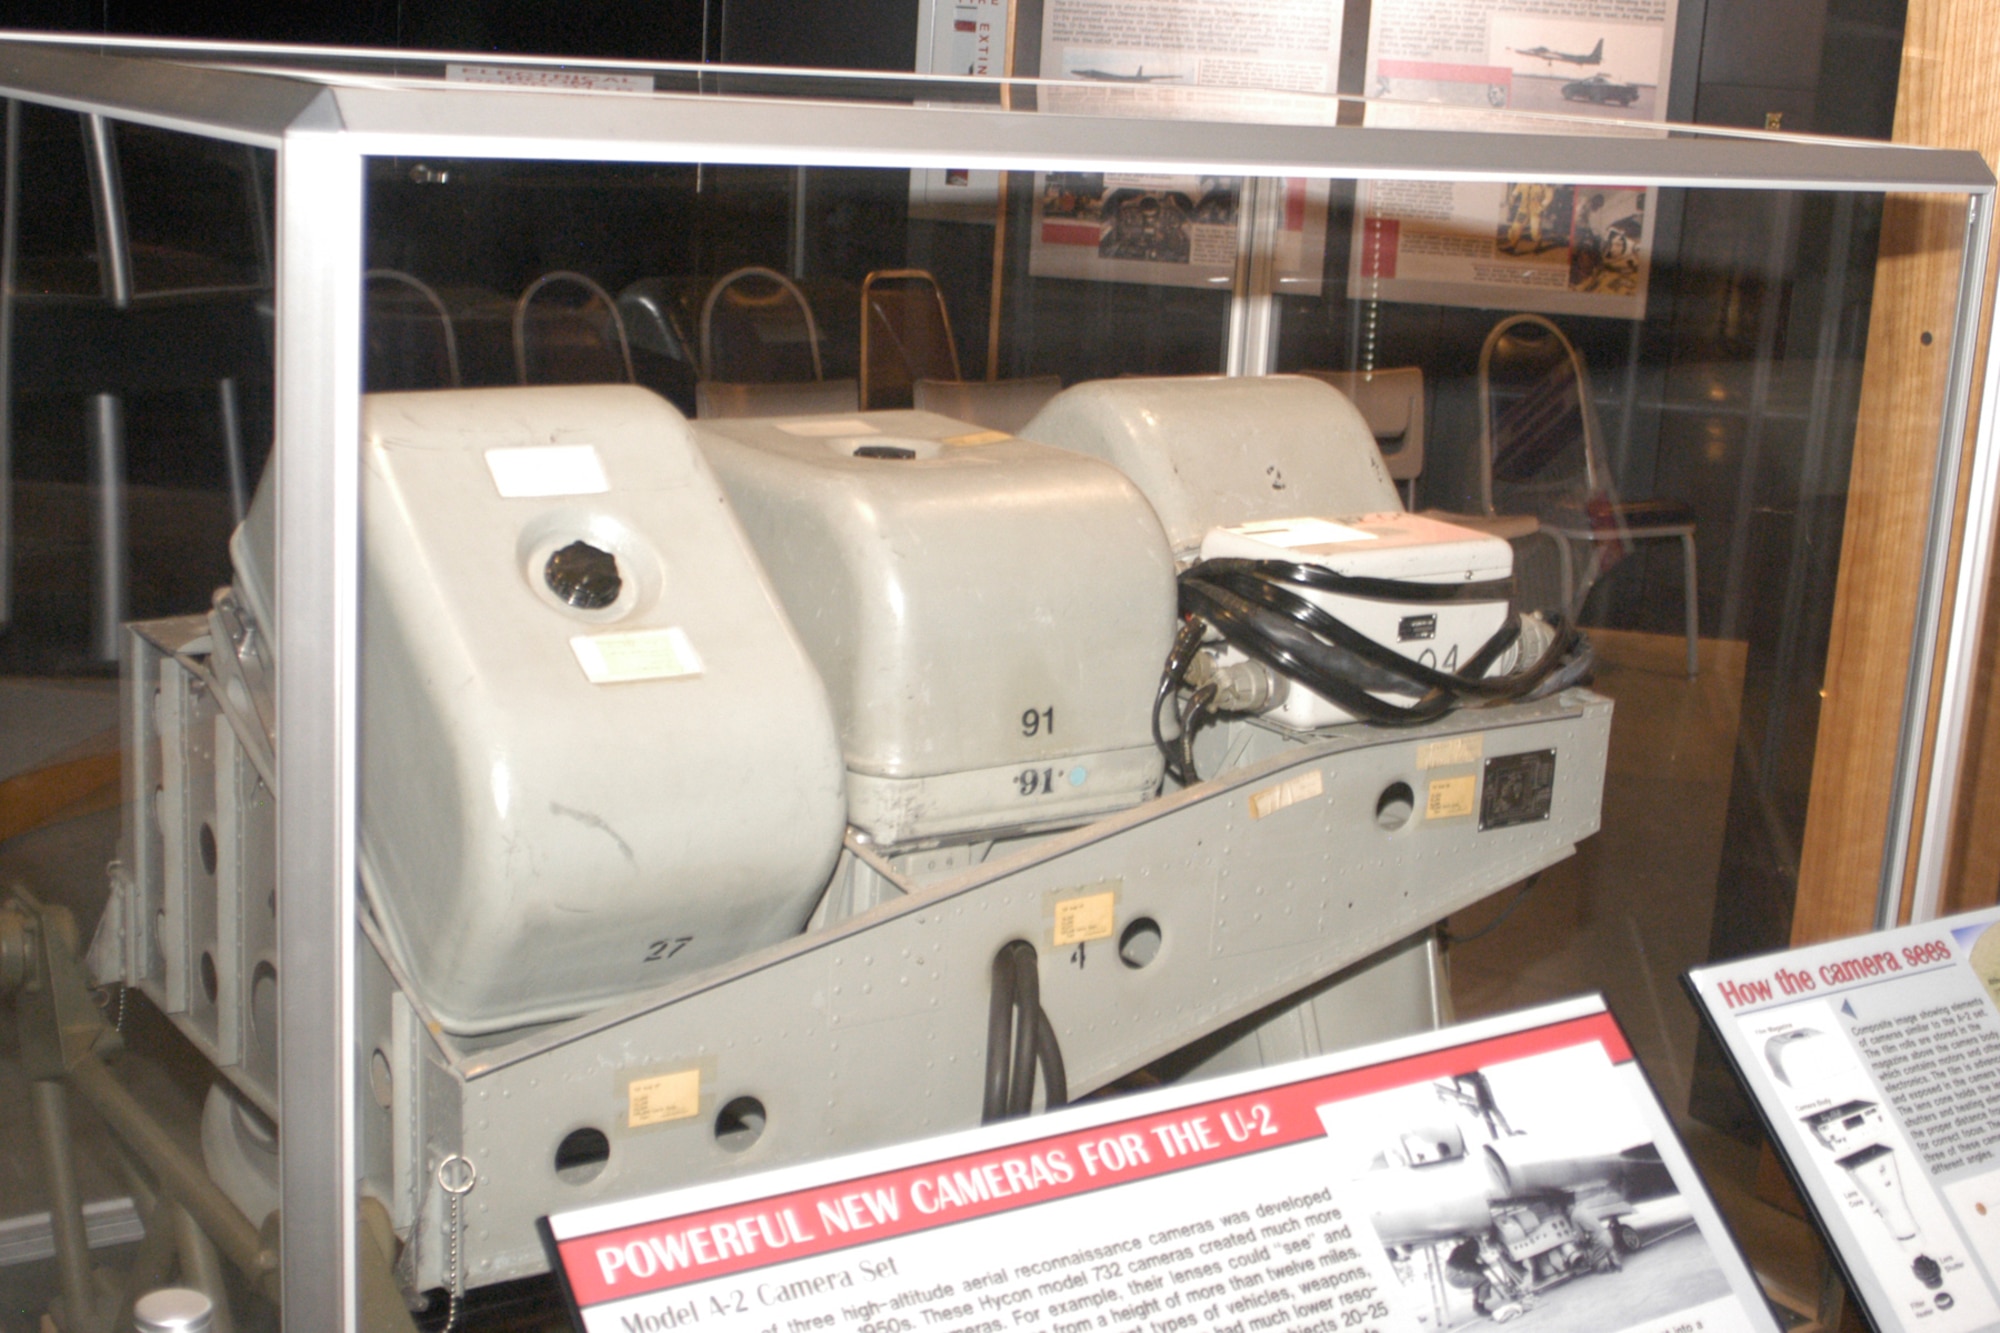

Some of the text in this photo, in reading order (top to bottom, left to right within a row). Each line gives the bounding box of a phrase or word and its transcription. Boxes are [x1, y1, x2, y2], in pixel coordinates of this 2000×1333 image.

[1021, 705, 1053, 737] 91
[1019, 767, 1053, 796] 91
[643, 936, 694, 963] 27
[1717, 940, 1952, 1008] How the camera sees
[1851, 1020, 1893, 1037] Composite
[1919, 1006, 1950, 1020] showing
[1859, 1038, 1868, 1048] of
[1869, 1031, 1903, 1045] cameras
[1904, 1023, 1930, 1036] similar
[1931, 1020, 1941, 1030] to
[1942, 1016, 1955, 1027] the
[1864, 1023, 1981, 1059] The film rolls are stored in the
[1871, 1054, 1910, 1070] magazine
[1910, 1048, 1934, 1060] above
[1935, 1043, 1949, 1053] the
[1950, 1036, 1980, 1050] camera
[1879, 1069, 1902, 1081] which
[1903, 1060, 1937, 1075] contains
[1938, 1053, 1965, 1065] motors
[1967, 1047, 1982, 1058] and
[1930, 1070, 1947, 1080] The
[1948, 1065, 1964, 1076] film
[1896, 1084, 1991, 1117] The lens cone holds the
[1908, 1083, 1943, 1100] exposed
[1943, 1081, 1952, 1091] in
[1952, 1078, 1966, 1088] the
[1968, 1070, 1997, 1084] camera
[1904, 1099, 1986, 1128] shutters and heating
[1910, 1112, 1988, 1140] the proper distance
[1923, 1151, 1946, 1163] three
[1947, 1145, 1956, 1157] of
[1957, 1140, 1980, 1153] these
[1931, 1132, 1960, 1147] correct
[1931, 1157, 1965, 1175] different
[595, 1103, 1278, 1285] POWERFUL NEW CAMERAS FOR THE U-2
[786, 1313, 836, 1333] three
[841, 1283, 954, 1322] high-altitude
[962, 1268, 1009, 1292] aerial
[1014, 1238, 1142, 1279] reconnaissance
[1148, 1219, 1215, 1246] cameras
[1219, 1210, 1251, 1227] was
[1255, 1187, 1333, 1219] developed
[919, 1302, 974, 1325] These
[978, 1286, 1034, 1312] Hycon
[1038, 1270, 1088, 1297] model
[1091, 1261, 1123, 1282] 732
[1128, 1246, 1195, 1273] cameras
[1198, 1227, 1257, 1256] created
[1260, 1217, 1302, 1239] much
[1304, 1207, 1343, 1228] more
[1012, 1308, 1041, 1327] For
[1048, 1287, 1124, 1318] example,
[1128, 1275, 1164, 1296] their
[1168, 1260, 1223, 1285] lenses
[1228, 1246, 1271, 1271] could
[1324, 1223, 1352, 1245] and
[621, 1256, 899, 1333] Model A-2 Camera Set
[1052, 1247, 1362, 1333] from a height of more than twelve miles.
[1150, 1266, 1372, 1333] types of vehicles, weapons,
[1247, 1308, 1291, 1332] much
[1292, 1297, 1334, 1320] lower
[1339, 1284, 1379, 1307] reso-
[1286, 1300, 1390, 1333] bjects 20-25
